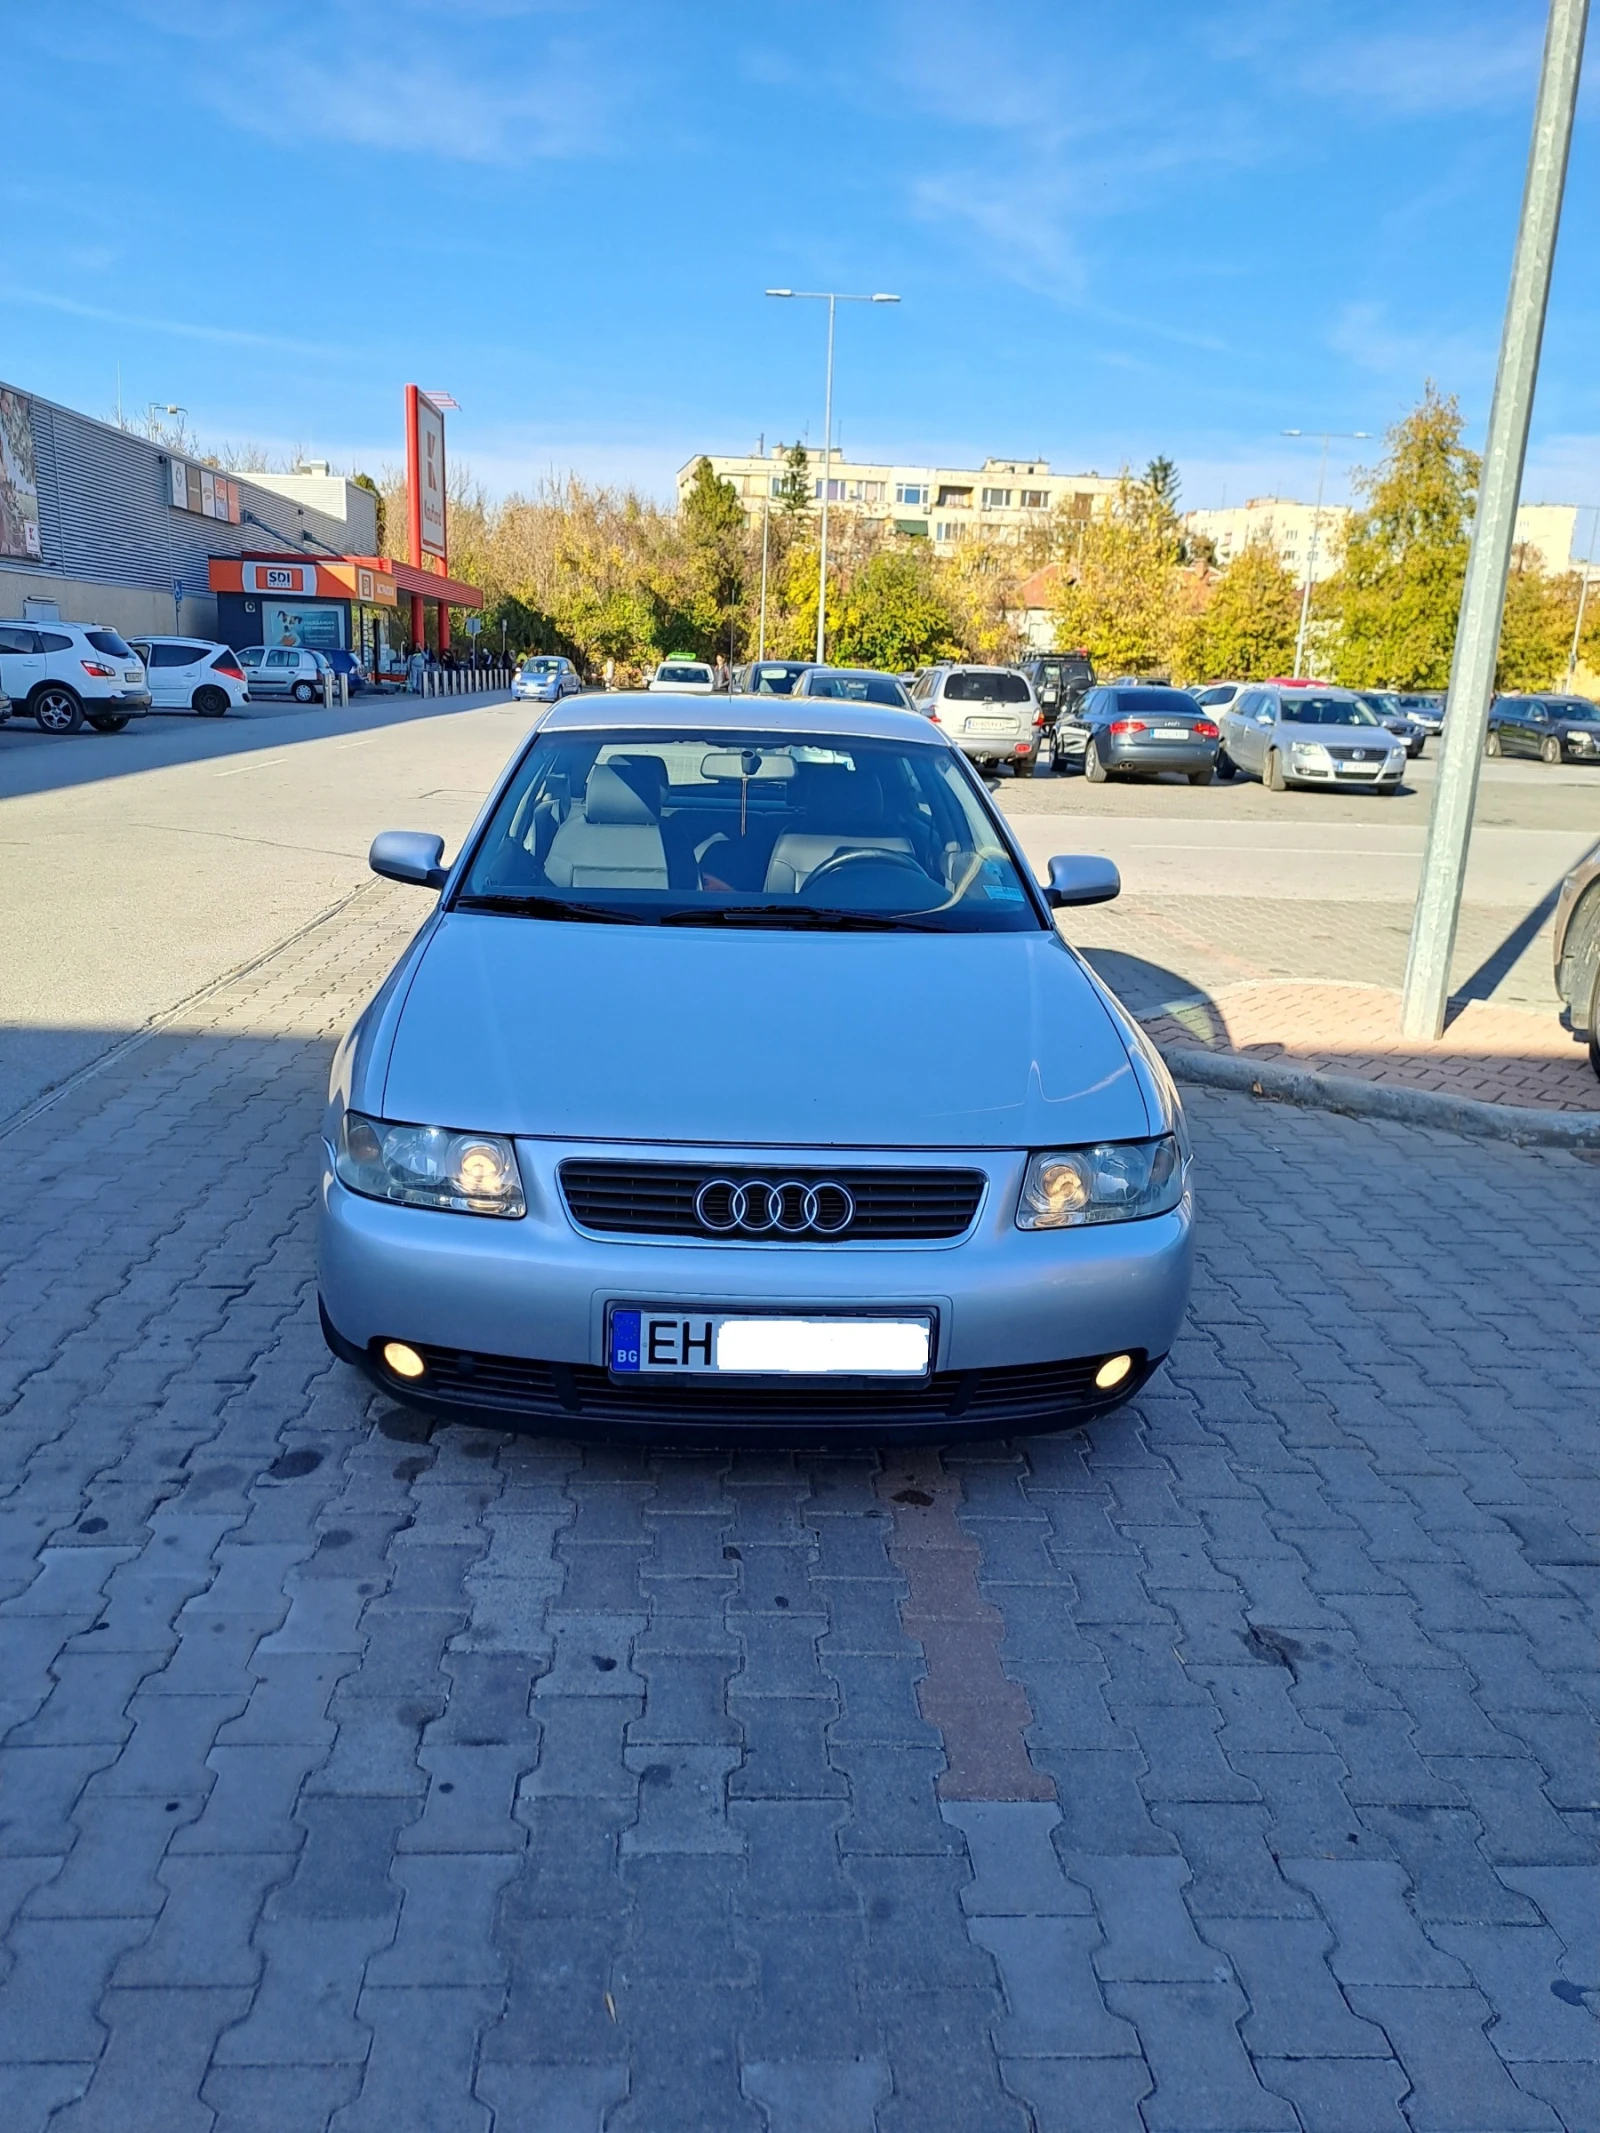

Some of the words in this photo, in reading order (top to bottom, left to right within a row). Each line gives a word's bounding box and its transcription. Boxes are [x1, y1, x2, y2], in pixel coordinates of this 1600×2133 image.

[269, 572, 290, 583] SDI
[649, 1322, 712, 1365] EH
[618, 1351, 637, 1362] BG
